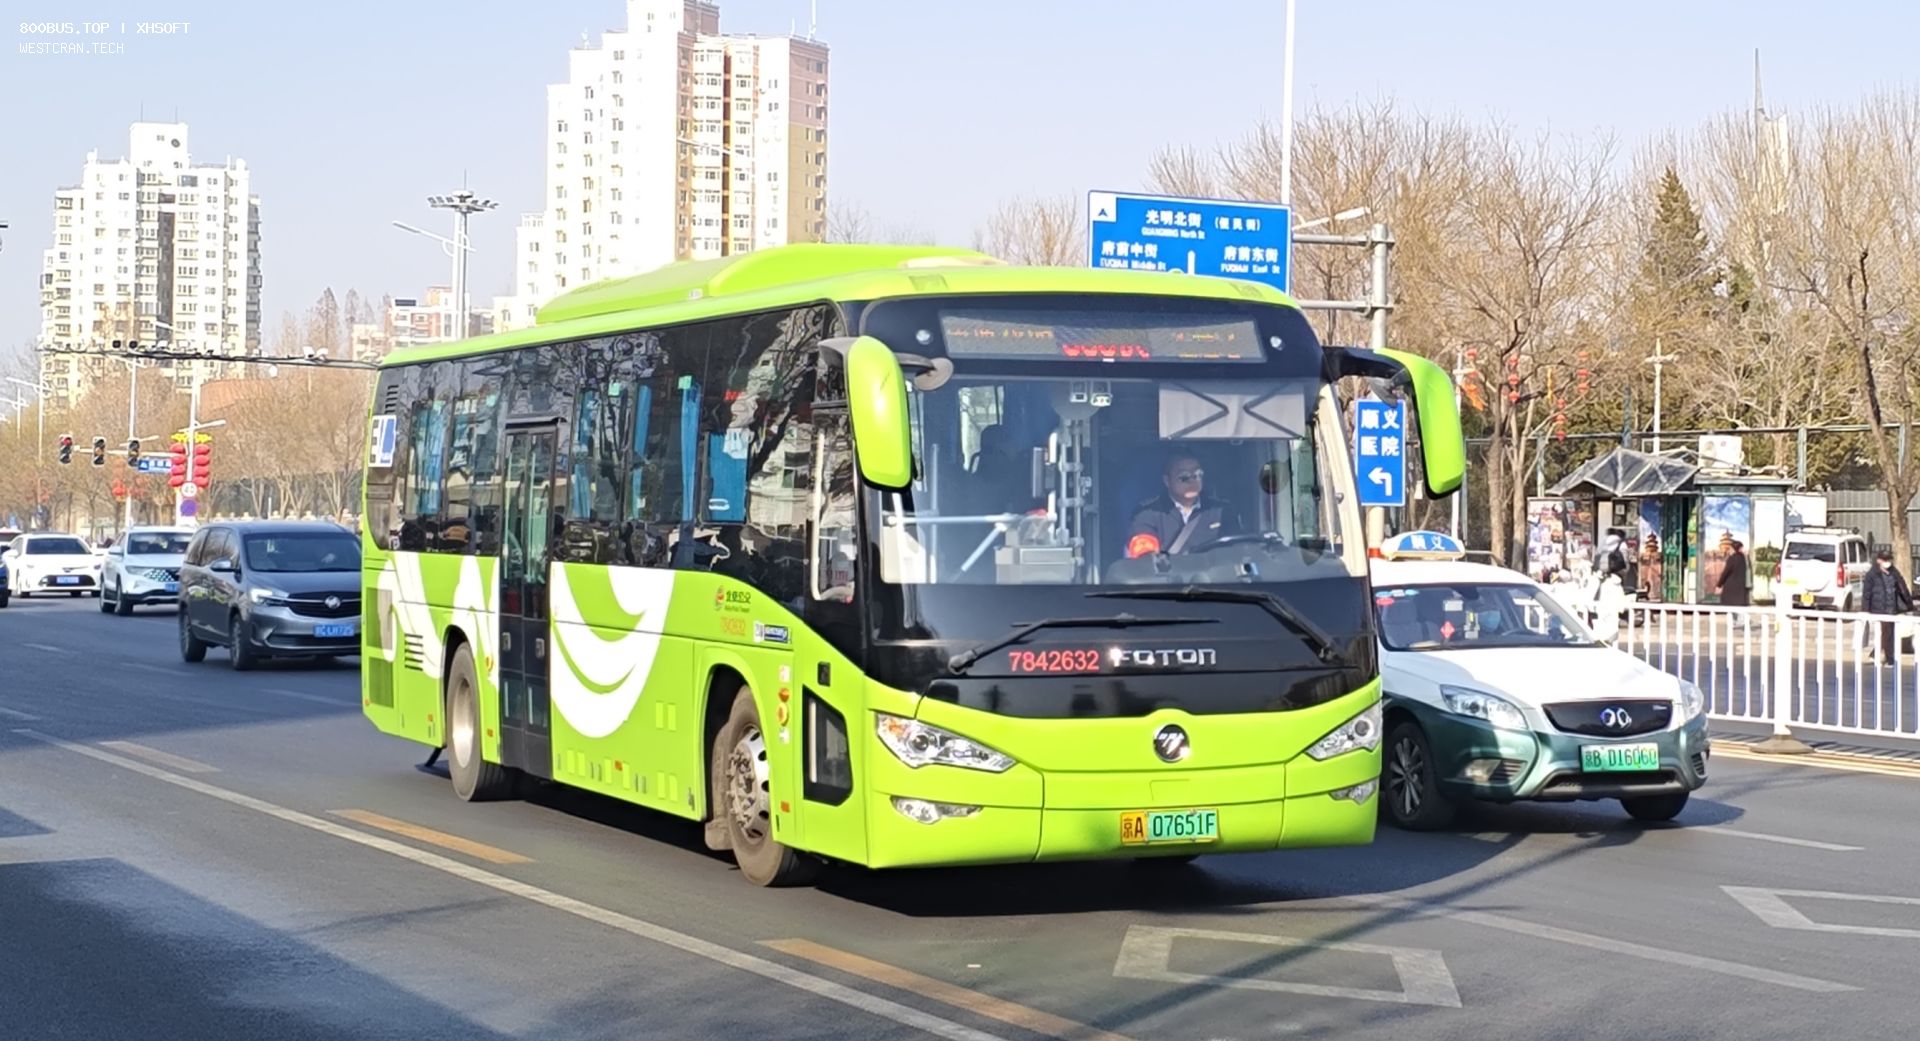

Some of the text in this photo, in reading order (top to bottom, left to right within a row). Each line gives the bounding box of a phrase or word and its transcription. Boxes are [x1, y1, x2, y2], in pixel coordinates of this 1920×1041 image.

[1145, 209, 1202, 228] 光明北街
[1101, 240, 1158, 258] 府前中街
[1223, 245, 1279, 263] 府前东街
[1361, 408, 1400, 429] 顺义
[1361, 436, 1400, 456] 医院
[1009, 646, 1218, 672] 7842632 FOTON
[1123, 813, 1216, 839] 京A 07651F
